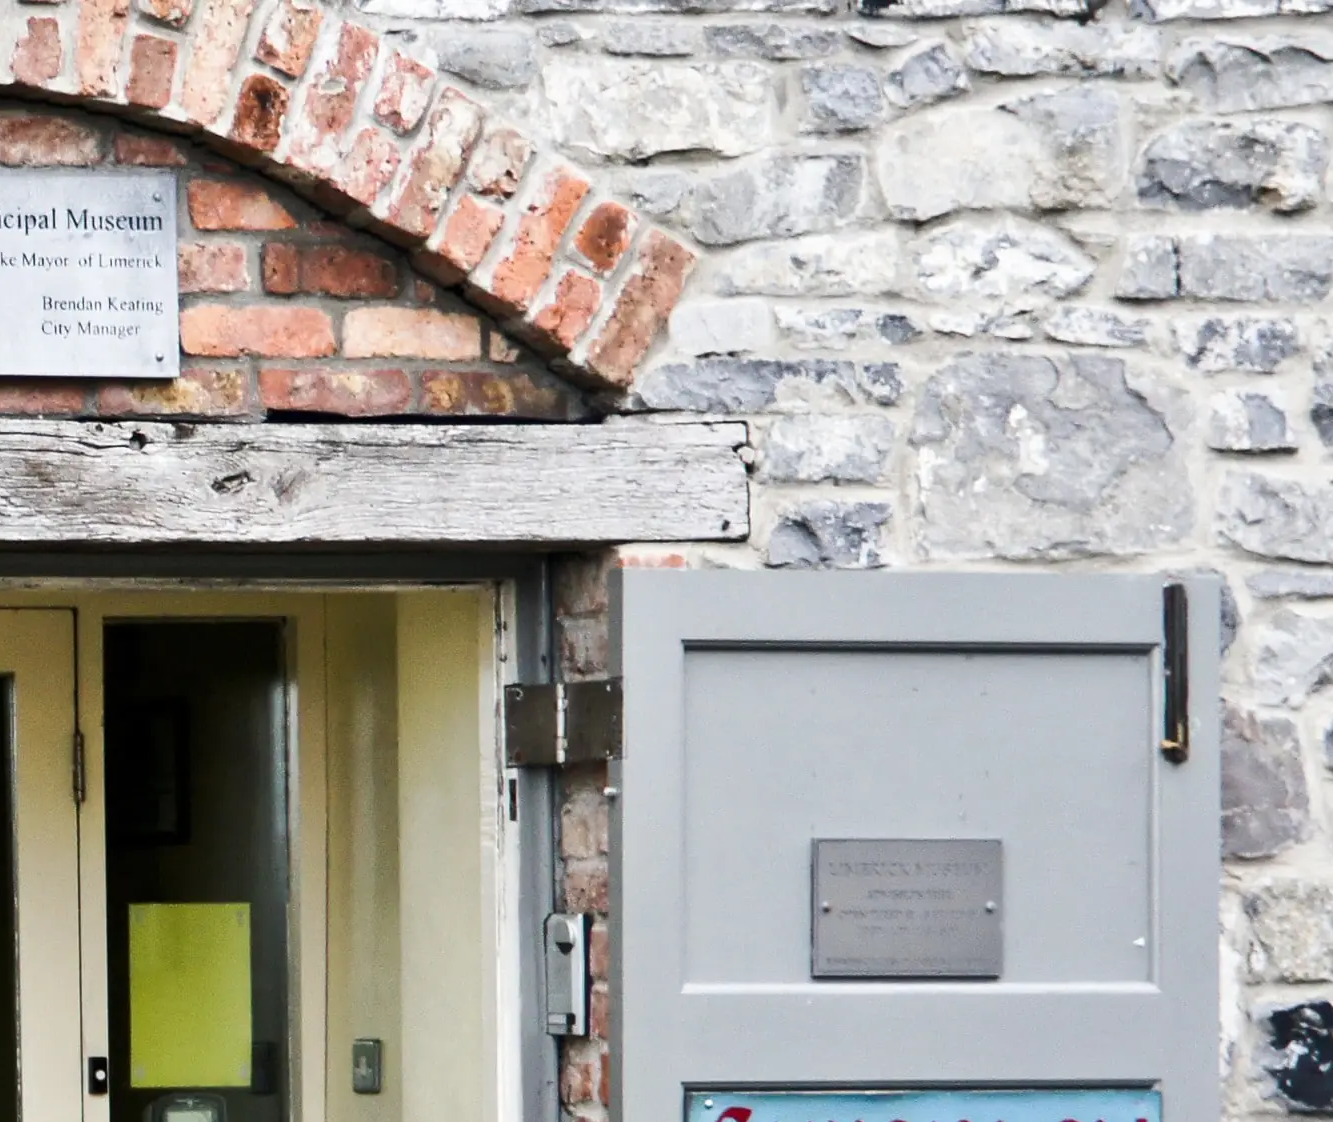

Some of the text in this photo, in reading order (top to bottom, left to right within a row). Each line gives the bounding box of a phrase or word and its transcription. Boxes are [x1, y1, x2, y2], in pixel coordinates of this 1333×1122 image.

[66, 208, 163, 231] Museum
[22, 252, 69, 271] Mayor
[78, 252, 93, 268] of
[42, 296, 164, 315] Brendan Keating
[41, 320, 141, 339] City Manager
